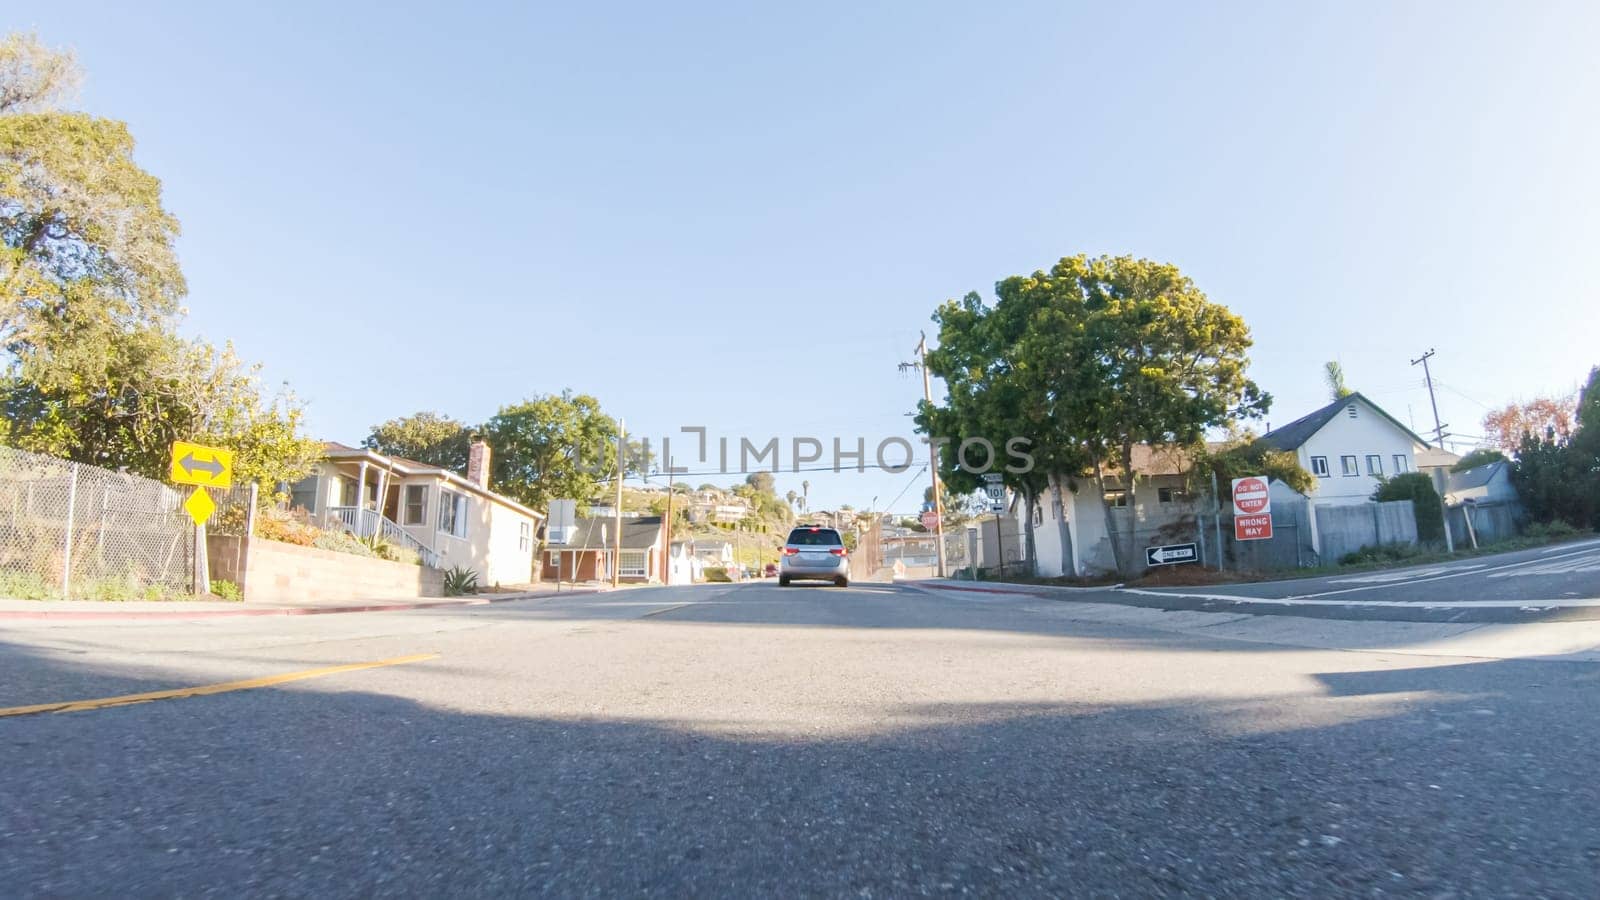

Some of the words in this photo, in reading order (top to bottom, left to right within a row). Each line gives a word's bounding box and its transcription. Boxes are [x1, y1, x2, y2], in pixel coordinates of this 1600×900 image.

[990, 488, 1003, 497] 101
[1241, 500, 1263, 508] ENTER
[1239, 517, 1268, 527] WRONG
[1245, 527, 1262, 536] WAY
[1162, 550, 1174, 558] ONE
[1176, 549, 1188, 557] WAY
